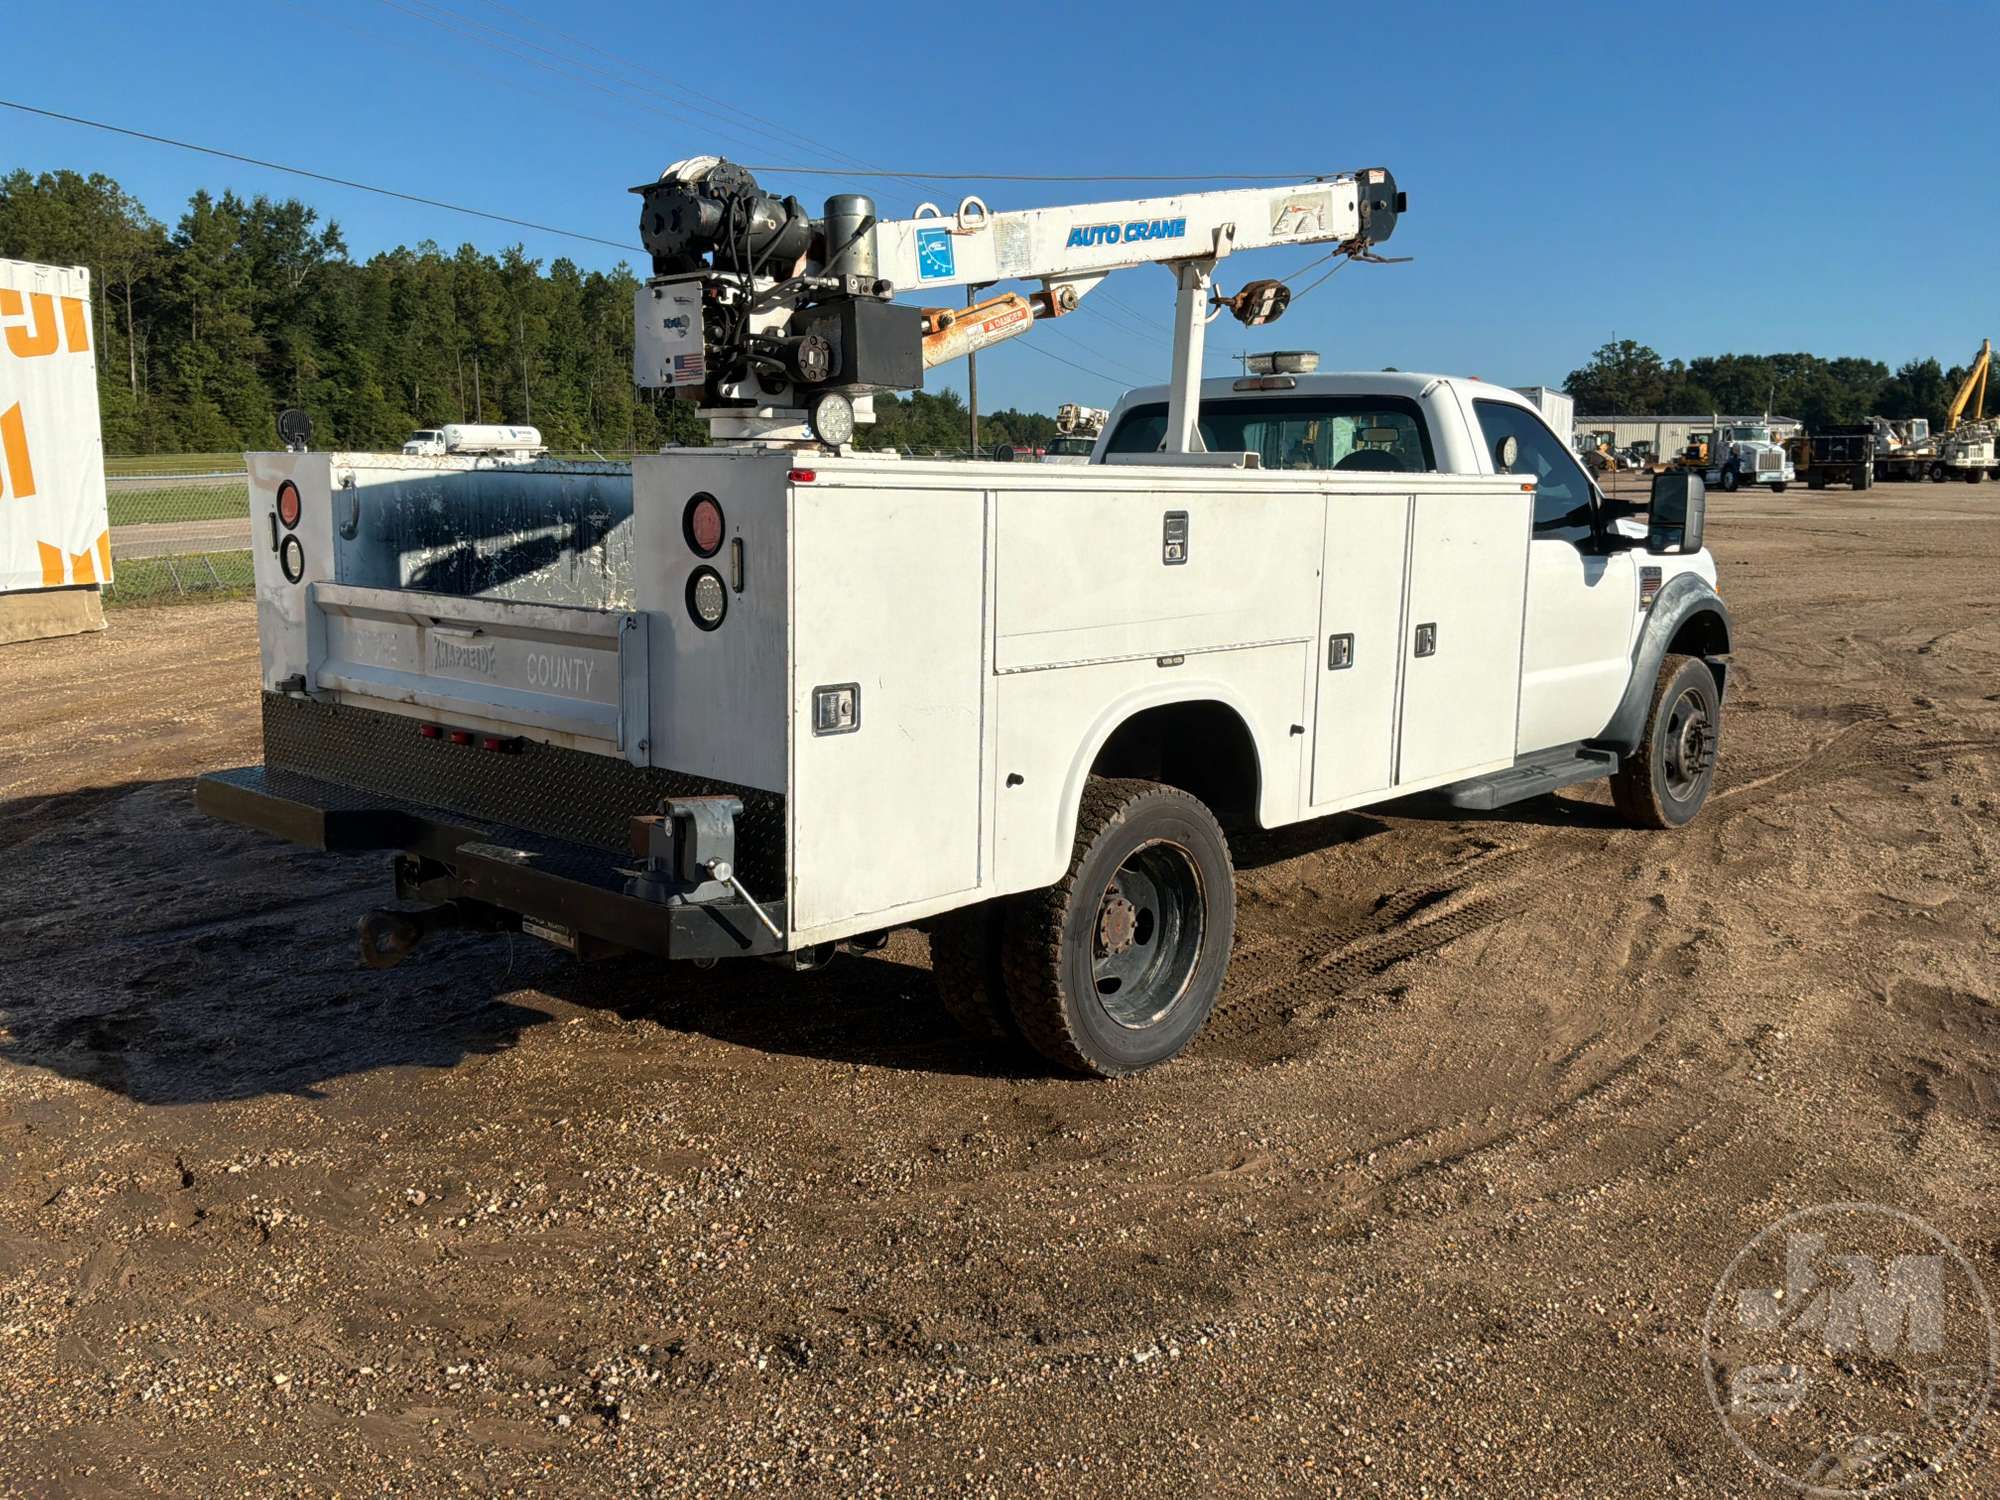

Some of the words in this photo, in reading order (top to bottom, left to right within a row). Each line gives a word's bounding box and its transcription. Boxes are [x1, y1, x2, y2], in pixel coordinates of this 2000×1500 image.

[1066, 224, 1120, 247] AUTO
[1124, 218, 1186, 242] CRANE
[995, 310, 1024, 327] DANGER
[527, 652, 594, 692] COUNTY
